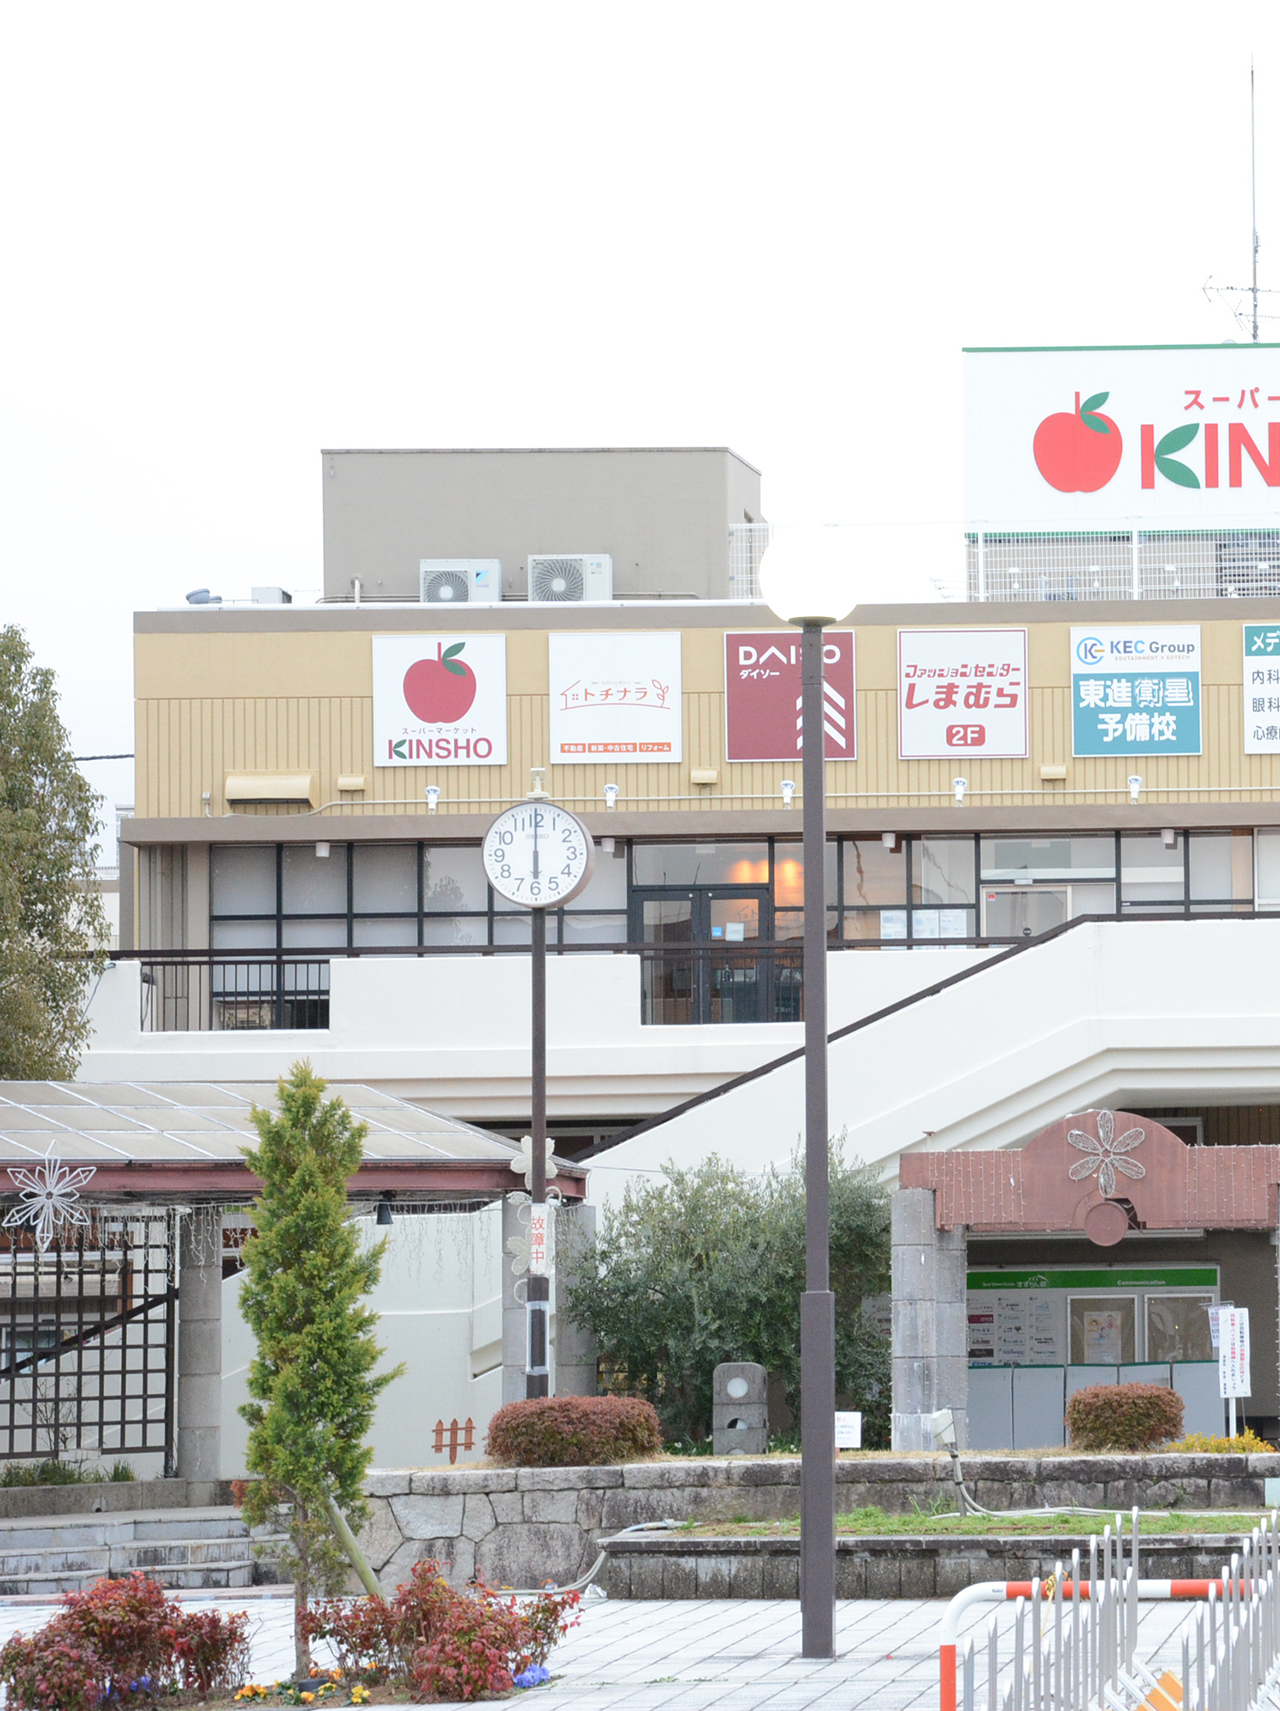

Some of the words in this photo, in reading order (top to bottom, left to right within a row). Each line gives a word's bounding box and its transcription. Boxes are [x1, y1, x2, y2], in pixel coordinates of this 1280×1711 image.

[1110, 641, 1145, 654] KEC
[1149, 641, 1195, 654] Group
[738, 645, 841, 666] DAIO
[739, 669, 780, 680] ダイソー
[904, 663, 1021, 679] ファッションセンター
[585, 687, 648, 701] トチナラ
[904, 681, 1021, 710] しまむら
[1078, 678, 1195, 708] 東進衛星
[402, 727, 477, 735] スーパーマーケット
[1097, 712, 1177, 742] 予備校
[951, 727, 980, 745] 2F
[387, 737, 493, 760] KINSHO
[563, 744, 584, 752] 不動産
[641, 743, 670, 751] リフォーム
[529, 813, 545, 828] 12
[552, 817, 556, 831] 1
[499, 831, 514, 846] 10
[561, 828, 573, 843] 2
[493, 848, 505, 863] 9
[566, 846, 578, 861] 3
[500, 864, 512, 879] 8
[560, 863, 572, 878] 4
[514, 878, 525, 892] 7
[530, 881, 542, 896] 6
[547, 876, 559, 891] 5
[530, 1215, 546, 1264] 故障中
